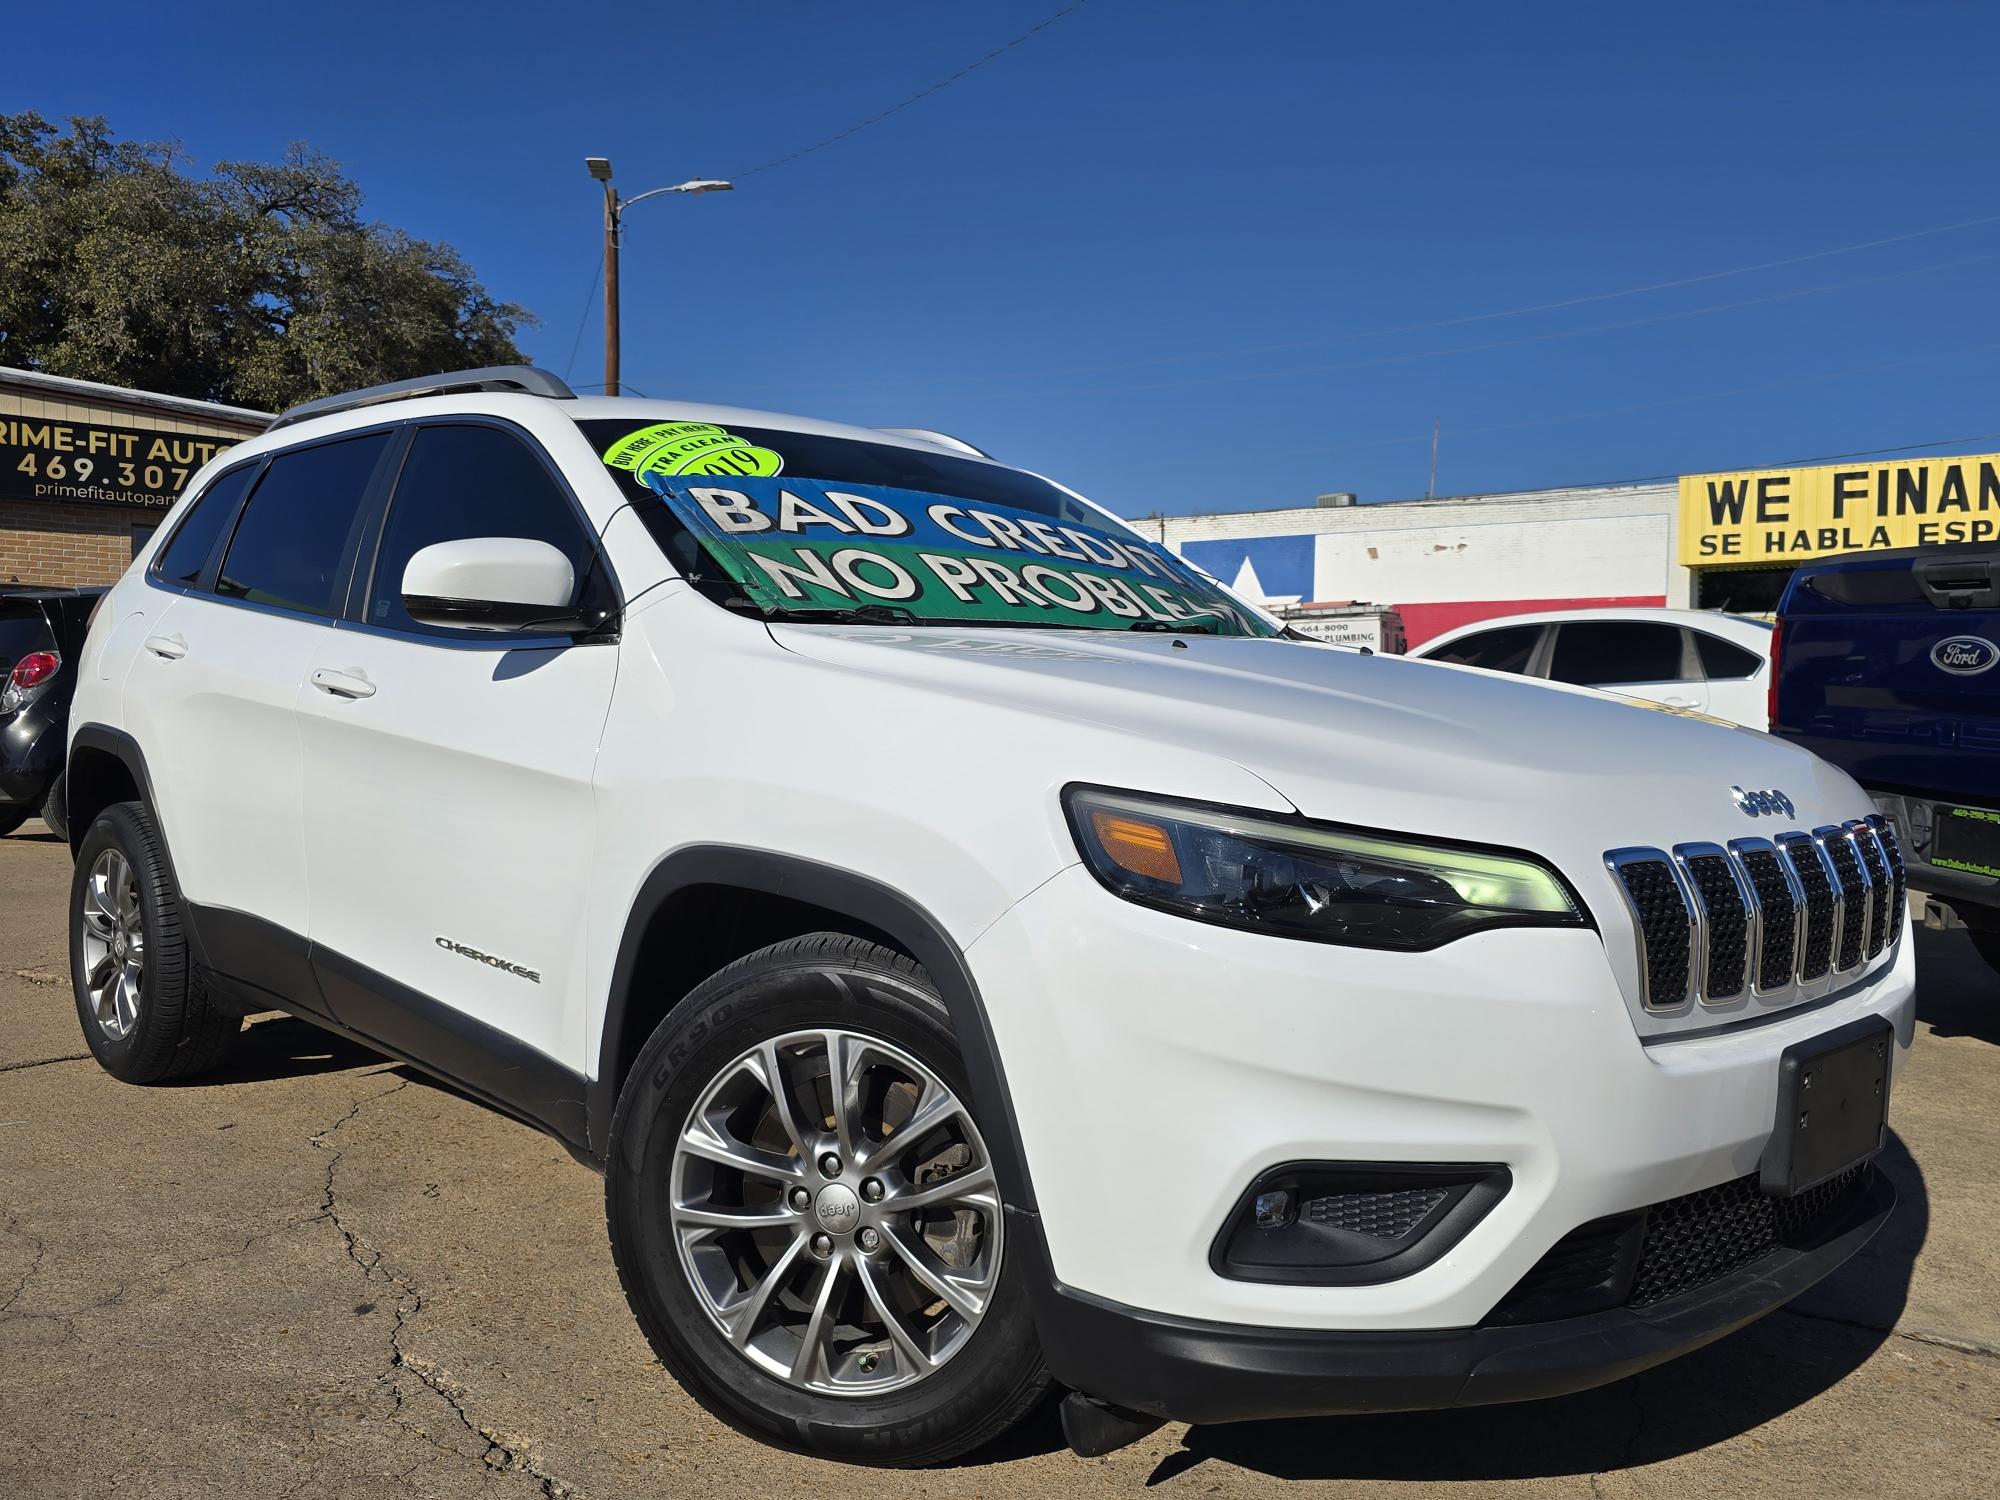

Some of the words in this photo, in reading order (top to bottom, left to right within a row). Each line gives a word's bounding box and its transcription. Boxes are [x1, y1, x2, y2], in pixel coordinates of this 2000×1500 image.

[0, 421, 139, 457] RIME-FIT
[613, 448, 632, 466] BUY
[626, 437, 657, 453] HERE
[654, 428, 677, 441] PAY
[679, 424, 713, 432] HERE
[680, 436, 735, 452] CLEAN
[690, 449, 760, 476] 019
[1707, 477, 1790, 526] WE
[1833, 462, 2000, 519] FINAN
[687, 487, 909, 536] BAD
[927, 504, 1186, 585] CREDIT
[1700, 534, 1742, 556] SE
[1765, 526, 1892, 553] HABLA
[747, 549, 917, 600] NO
[1325, 633, 1375, 642] PLUMBING
[1943, 643, 1981, 665] Ford
[1729, 785, 1796, 821] Jeep
[435, 937, 541, 984] CHEROKEE
